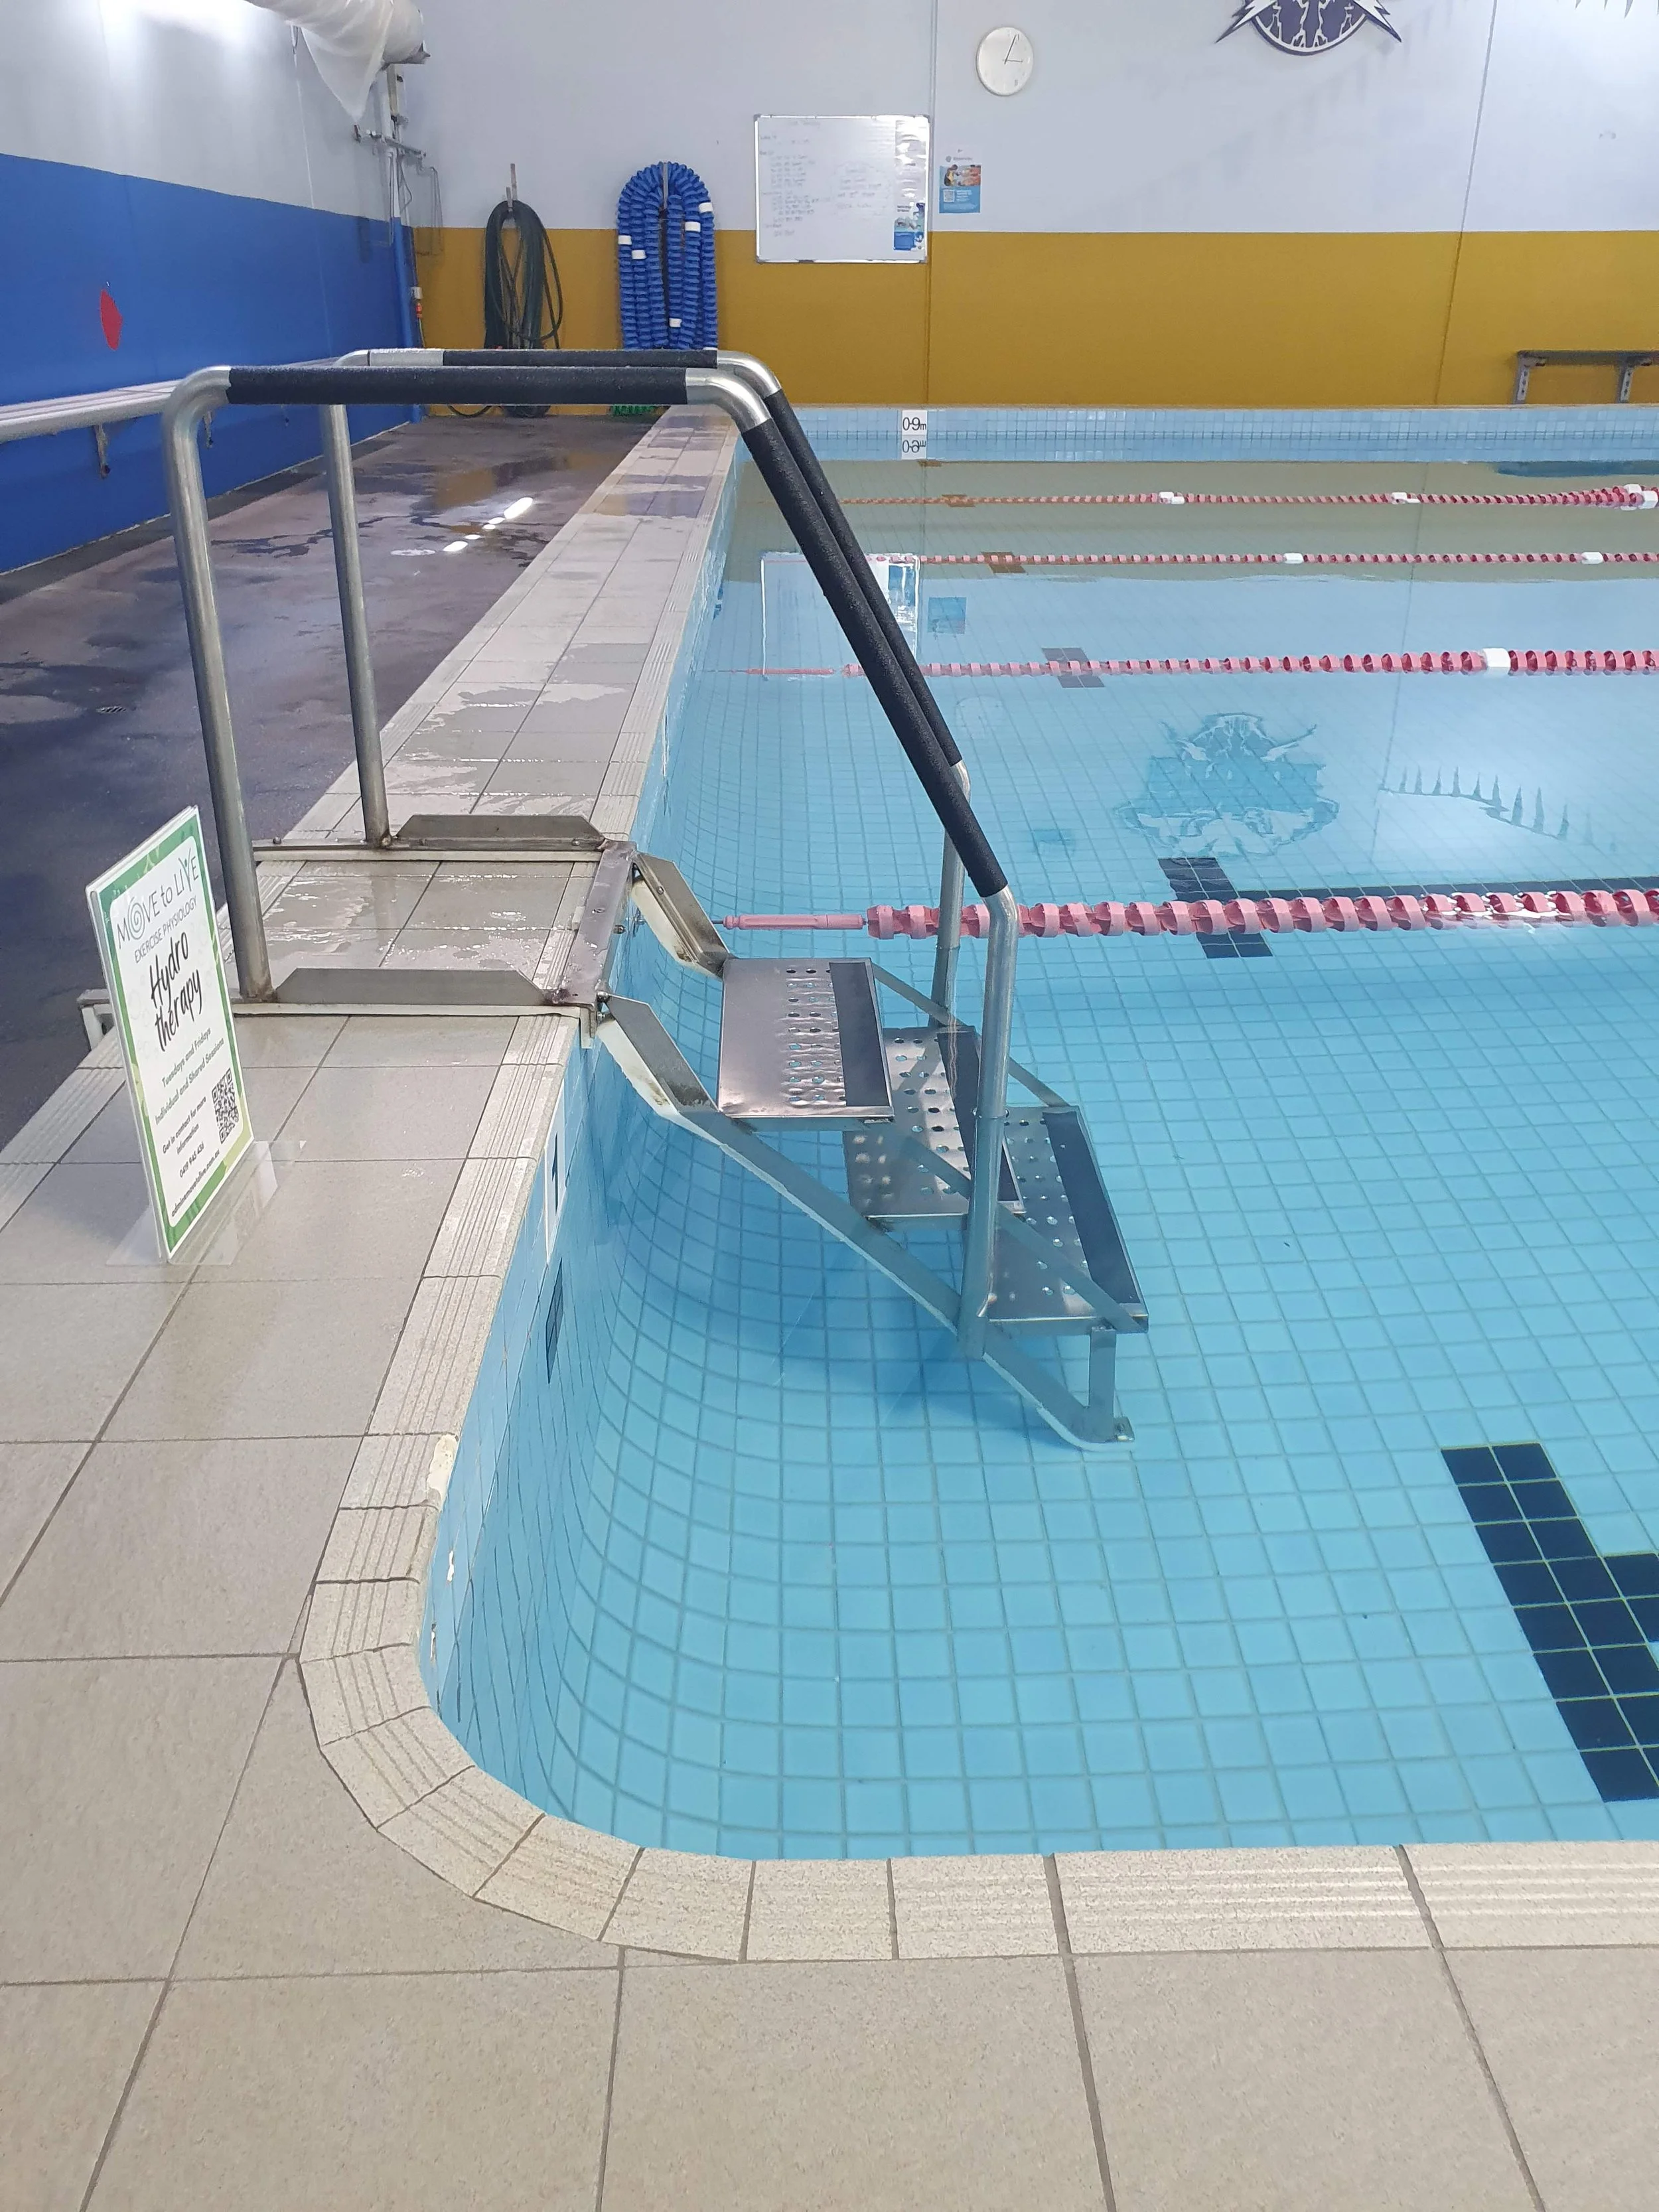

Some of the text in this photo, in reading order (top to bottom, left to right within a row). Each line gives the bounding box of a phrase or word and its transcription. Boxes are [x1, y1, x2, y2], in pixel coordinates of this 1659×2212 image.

[117, 848, 198, 949] MOVE to LIVE
[135, 896, 197, 963] EXERCISE PHYSIOLOGY
[149, 932, 188, 1013] Hydro
[155, 969, 202, 1052] therapy
[155, 1038, 224, 1125] Individual and Shared Sessions
[162, 1027, 211, 1088] Tuesdays and Fridays
[171, 1136, 175, 1145] in
[175, 1115, 190, 1138] contact
[196, 1096, 206, 1112] more
[176, 1124, 199, 1155] information
